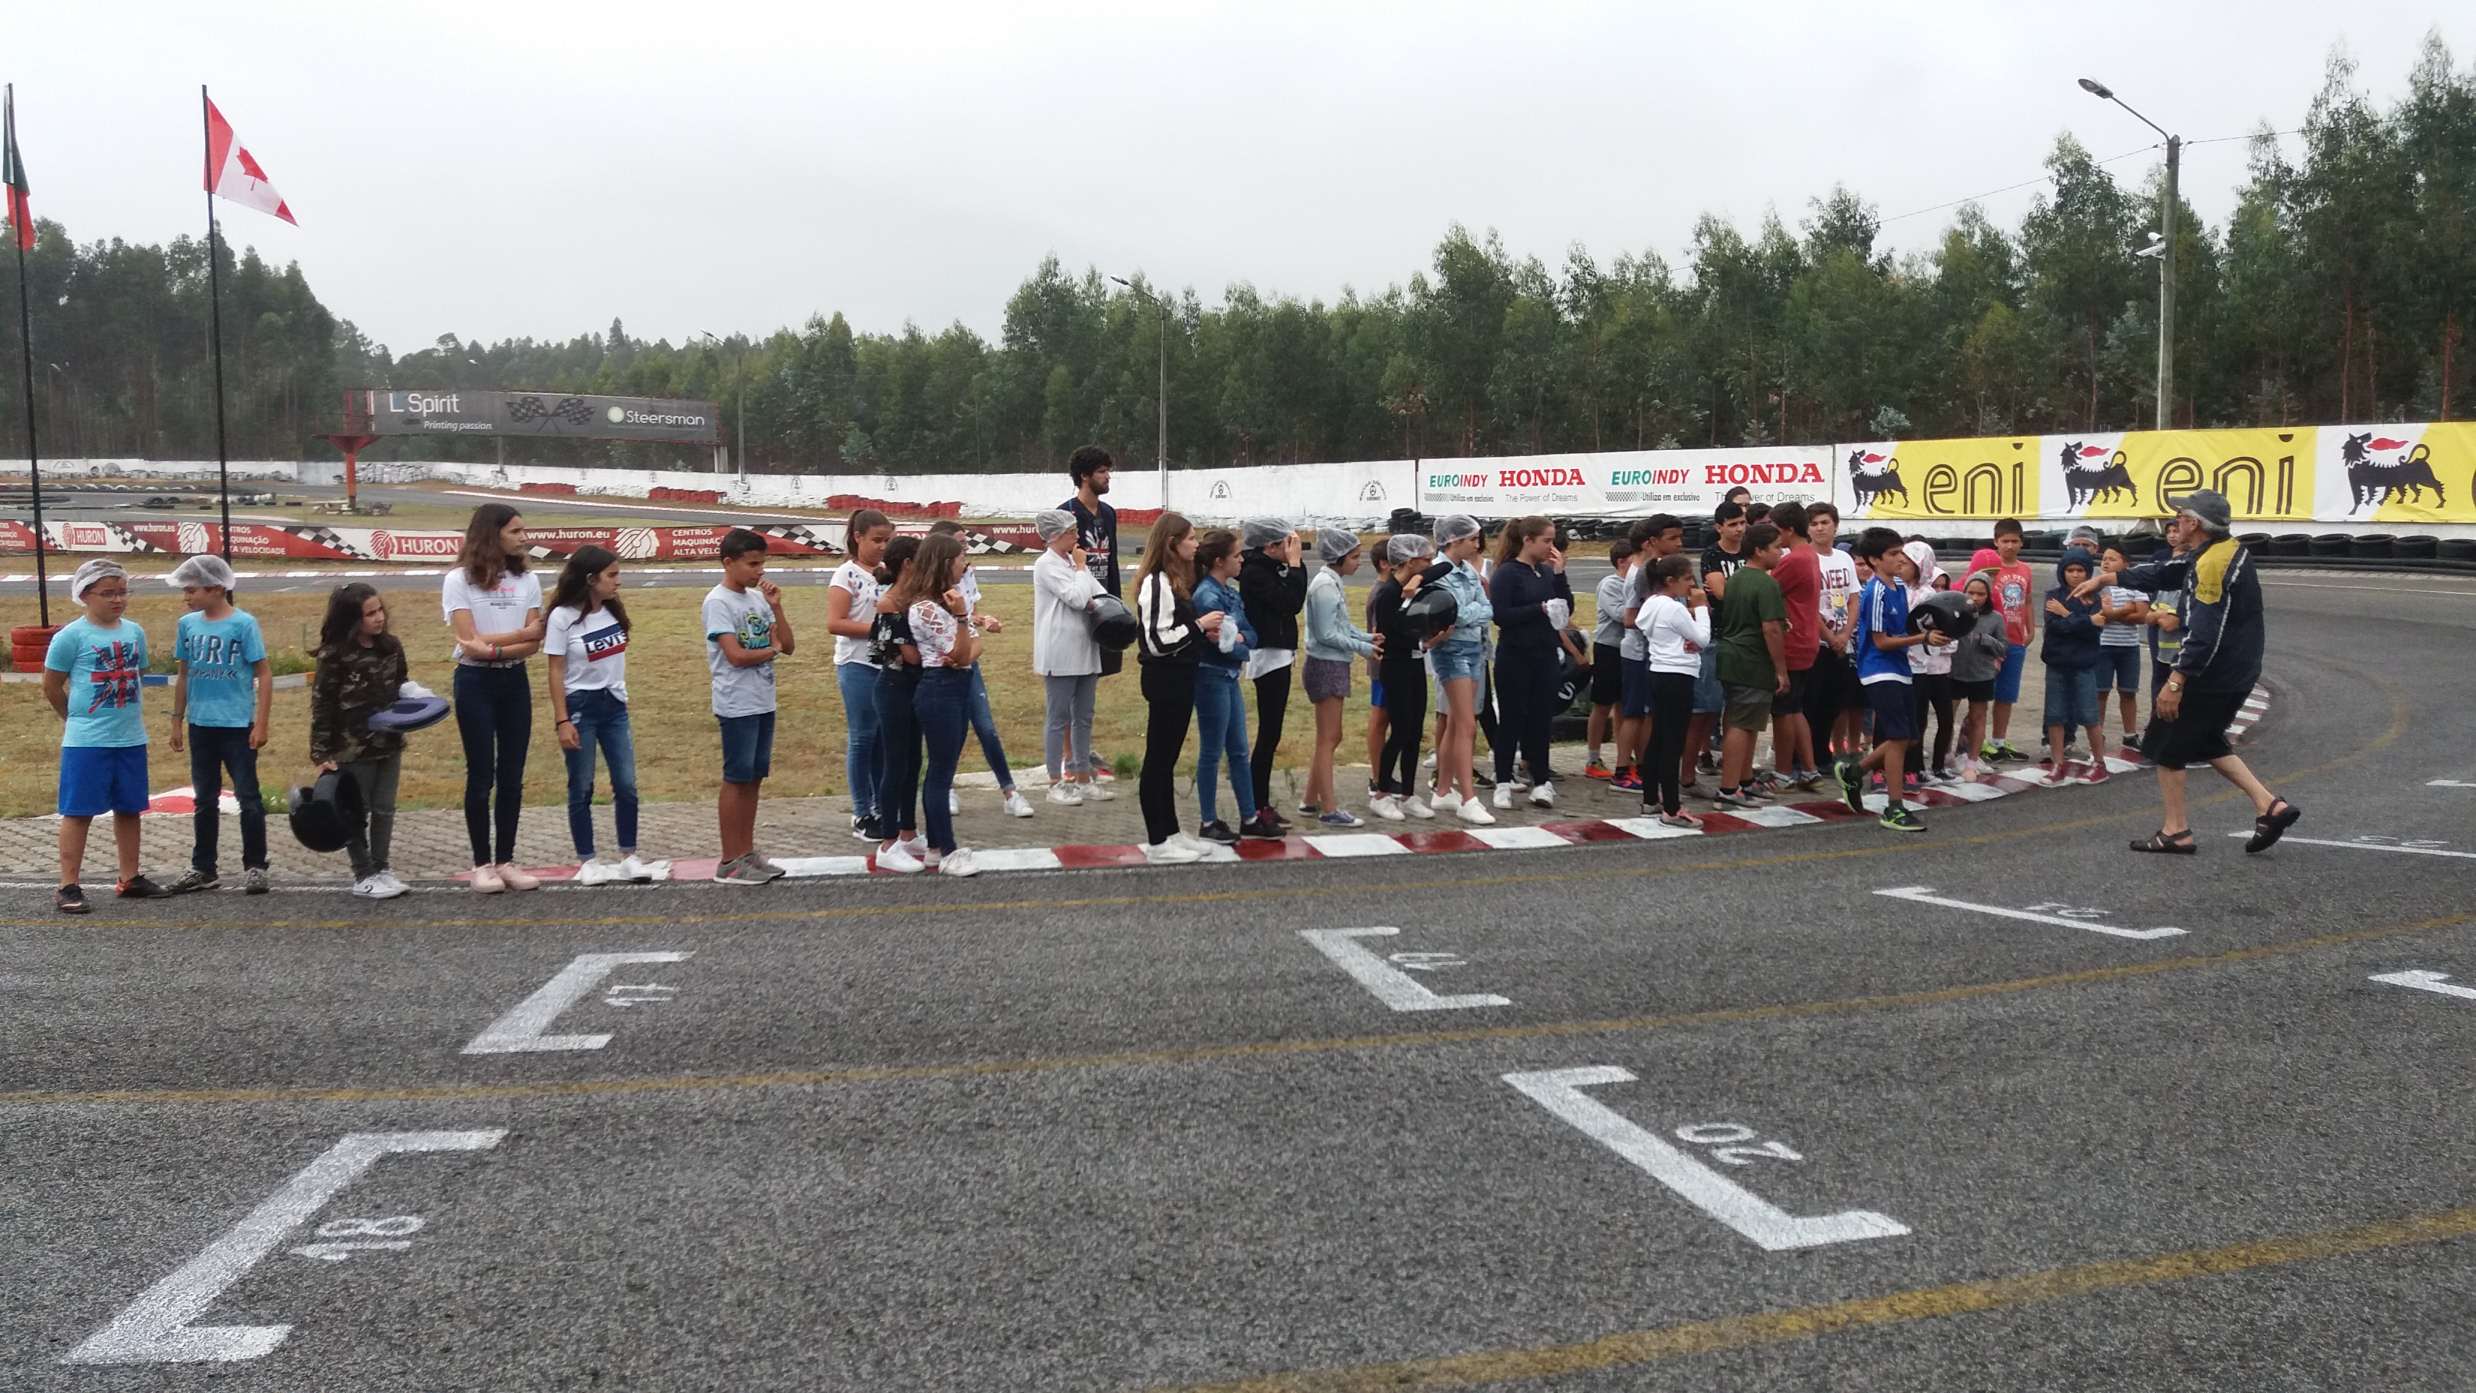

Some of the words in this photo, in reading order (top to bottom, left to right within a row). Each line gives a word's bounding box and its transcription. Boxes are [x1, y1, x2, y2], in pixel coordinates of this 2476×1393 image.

[407, 393, 461, 418] Spirit
[423, 420, 458, 432] Printing
[626, 410, 705, 426] Steersman
[1429, 474, 1489, 488] EUROINDY
[1499, 468, 1586, 487] HONDA
[1611, 469, 1690, 485] EUROINDY
[1705, 463, 1825, 485] HONDA
[1923, 442, 2024, 515] eni
[2156, 433, 2294, 515] eni
[1765, 492, 1774, 502] of
[1777, 492, 1815, 503] Dreams
[76, 529, 106, 545] HURON
[527, 528, 610, 540] www.huron.eu
[671, 528, 713, 537] CENTROS
[402, 538, 459, 556] HURON
[673, 548, 697, 556] ALTA
[1675, 1122, 1803, 1166] 20
[288, 1215, 427, 1261] 18
